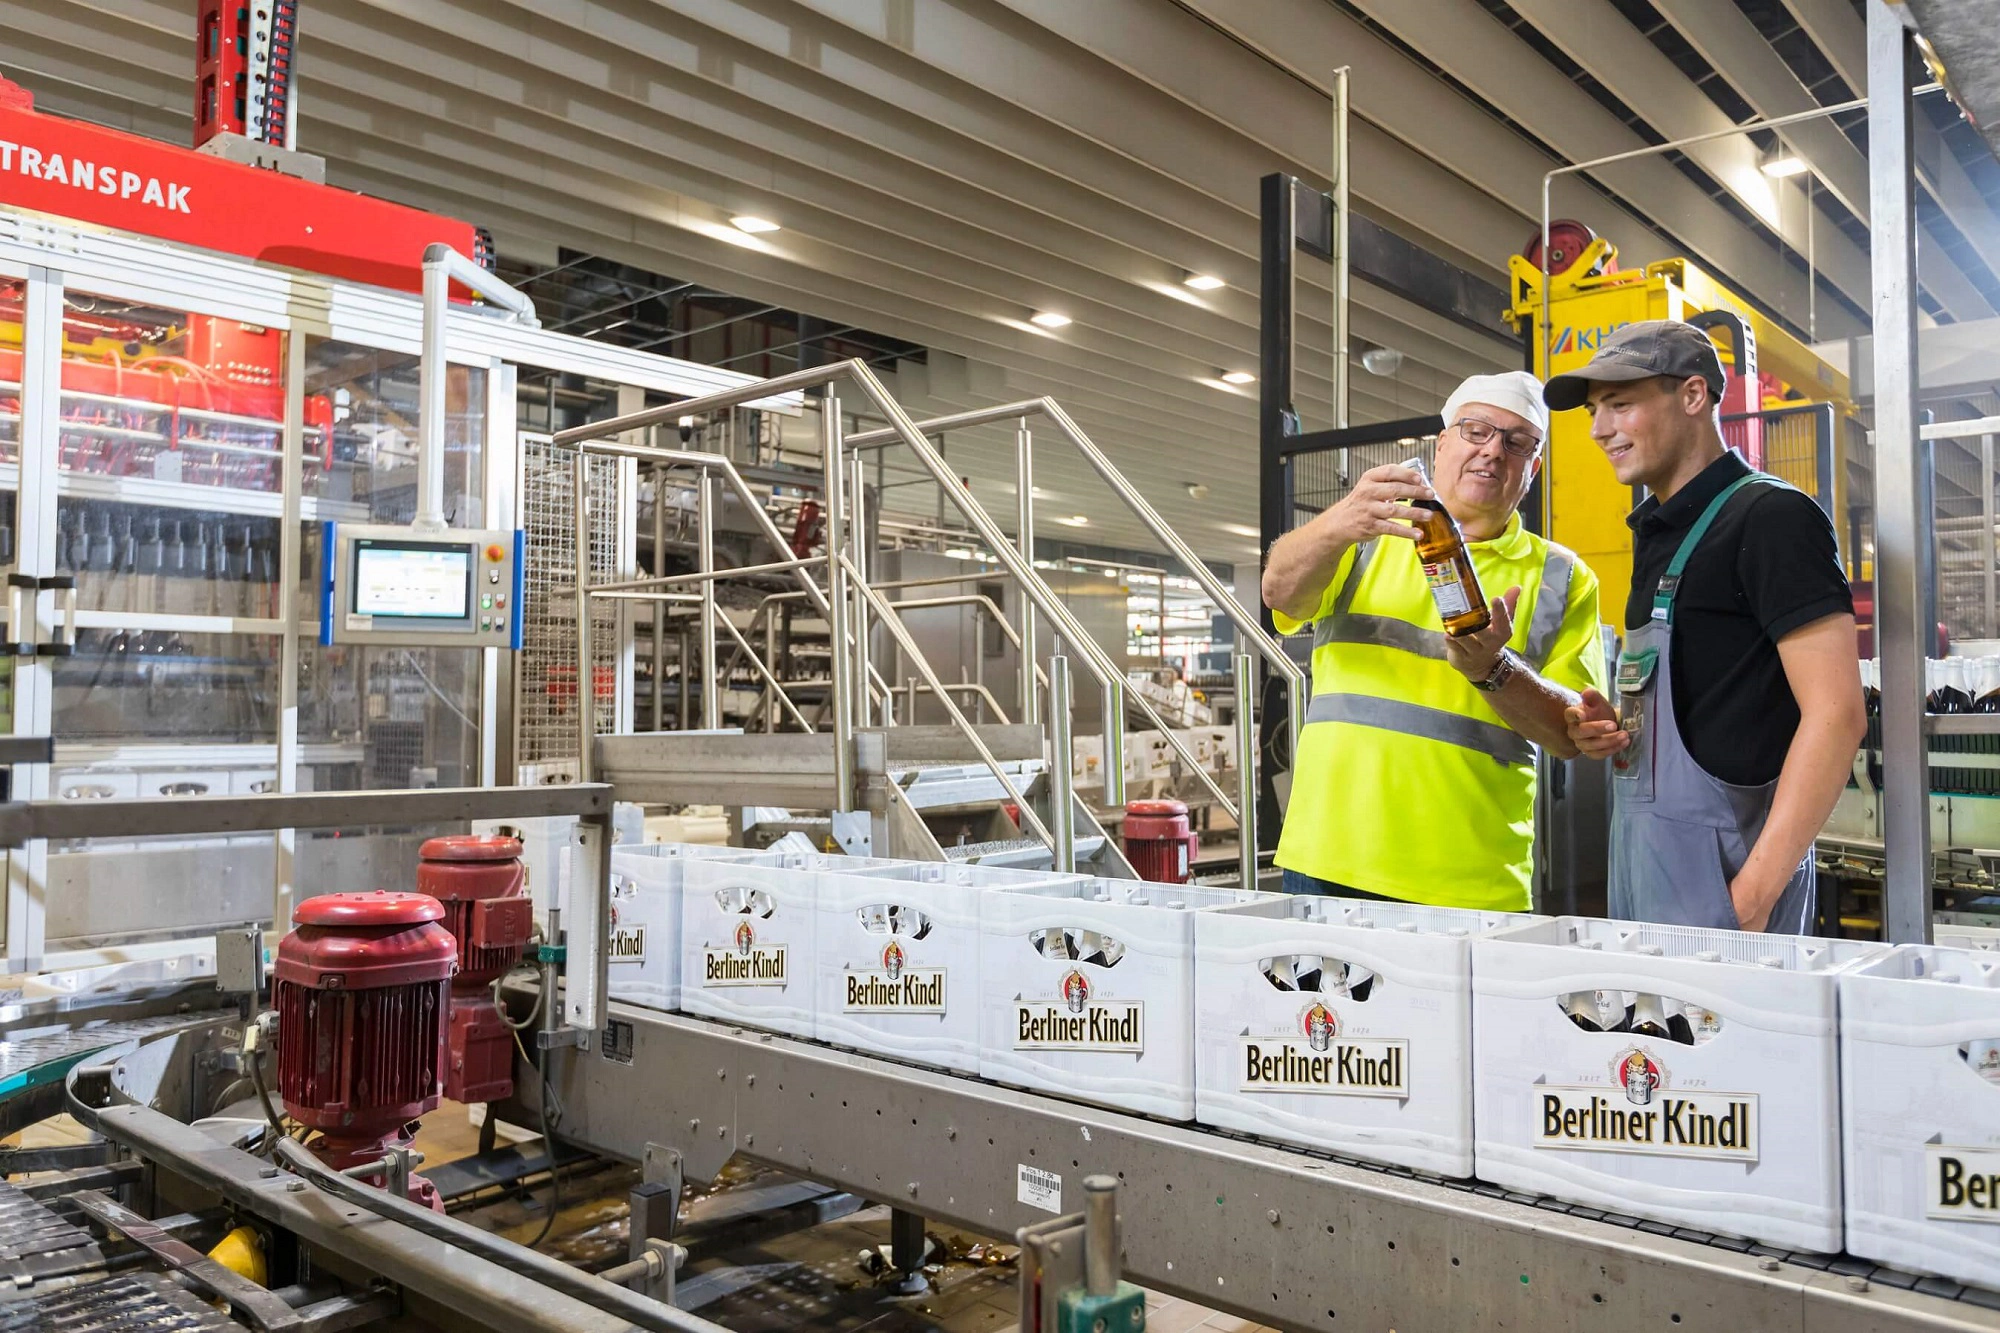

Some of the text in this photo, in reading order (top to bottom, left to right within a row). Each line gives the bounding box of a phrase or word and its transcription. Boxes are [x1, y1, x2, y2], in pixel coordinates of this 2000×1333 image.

[0, 140, 191, 214] TRANSPAK
[1577, 322, 1630, 351] KH
[617, 929, 643, 956] Kindl
[707, 949, 784, 980] Berliner Kindl
[847, 974, 942, 1006] Berliner Kindl
[1019, 1008, 1138, 1043] Berliner Kindl
[1246, 1044, 1402, 1088] Berliner Kindl
[1542, 1094, 1750, 1150] Berliner Kindl
